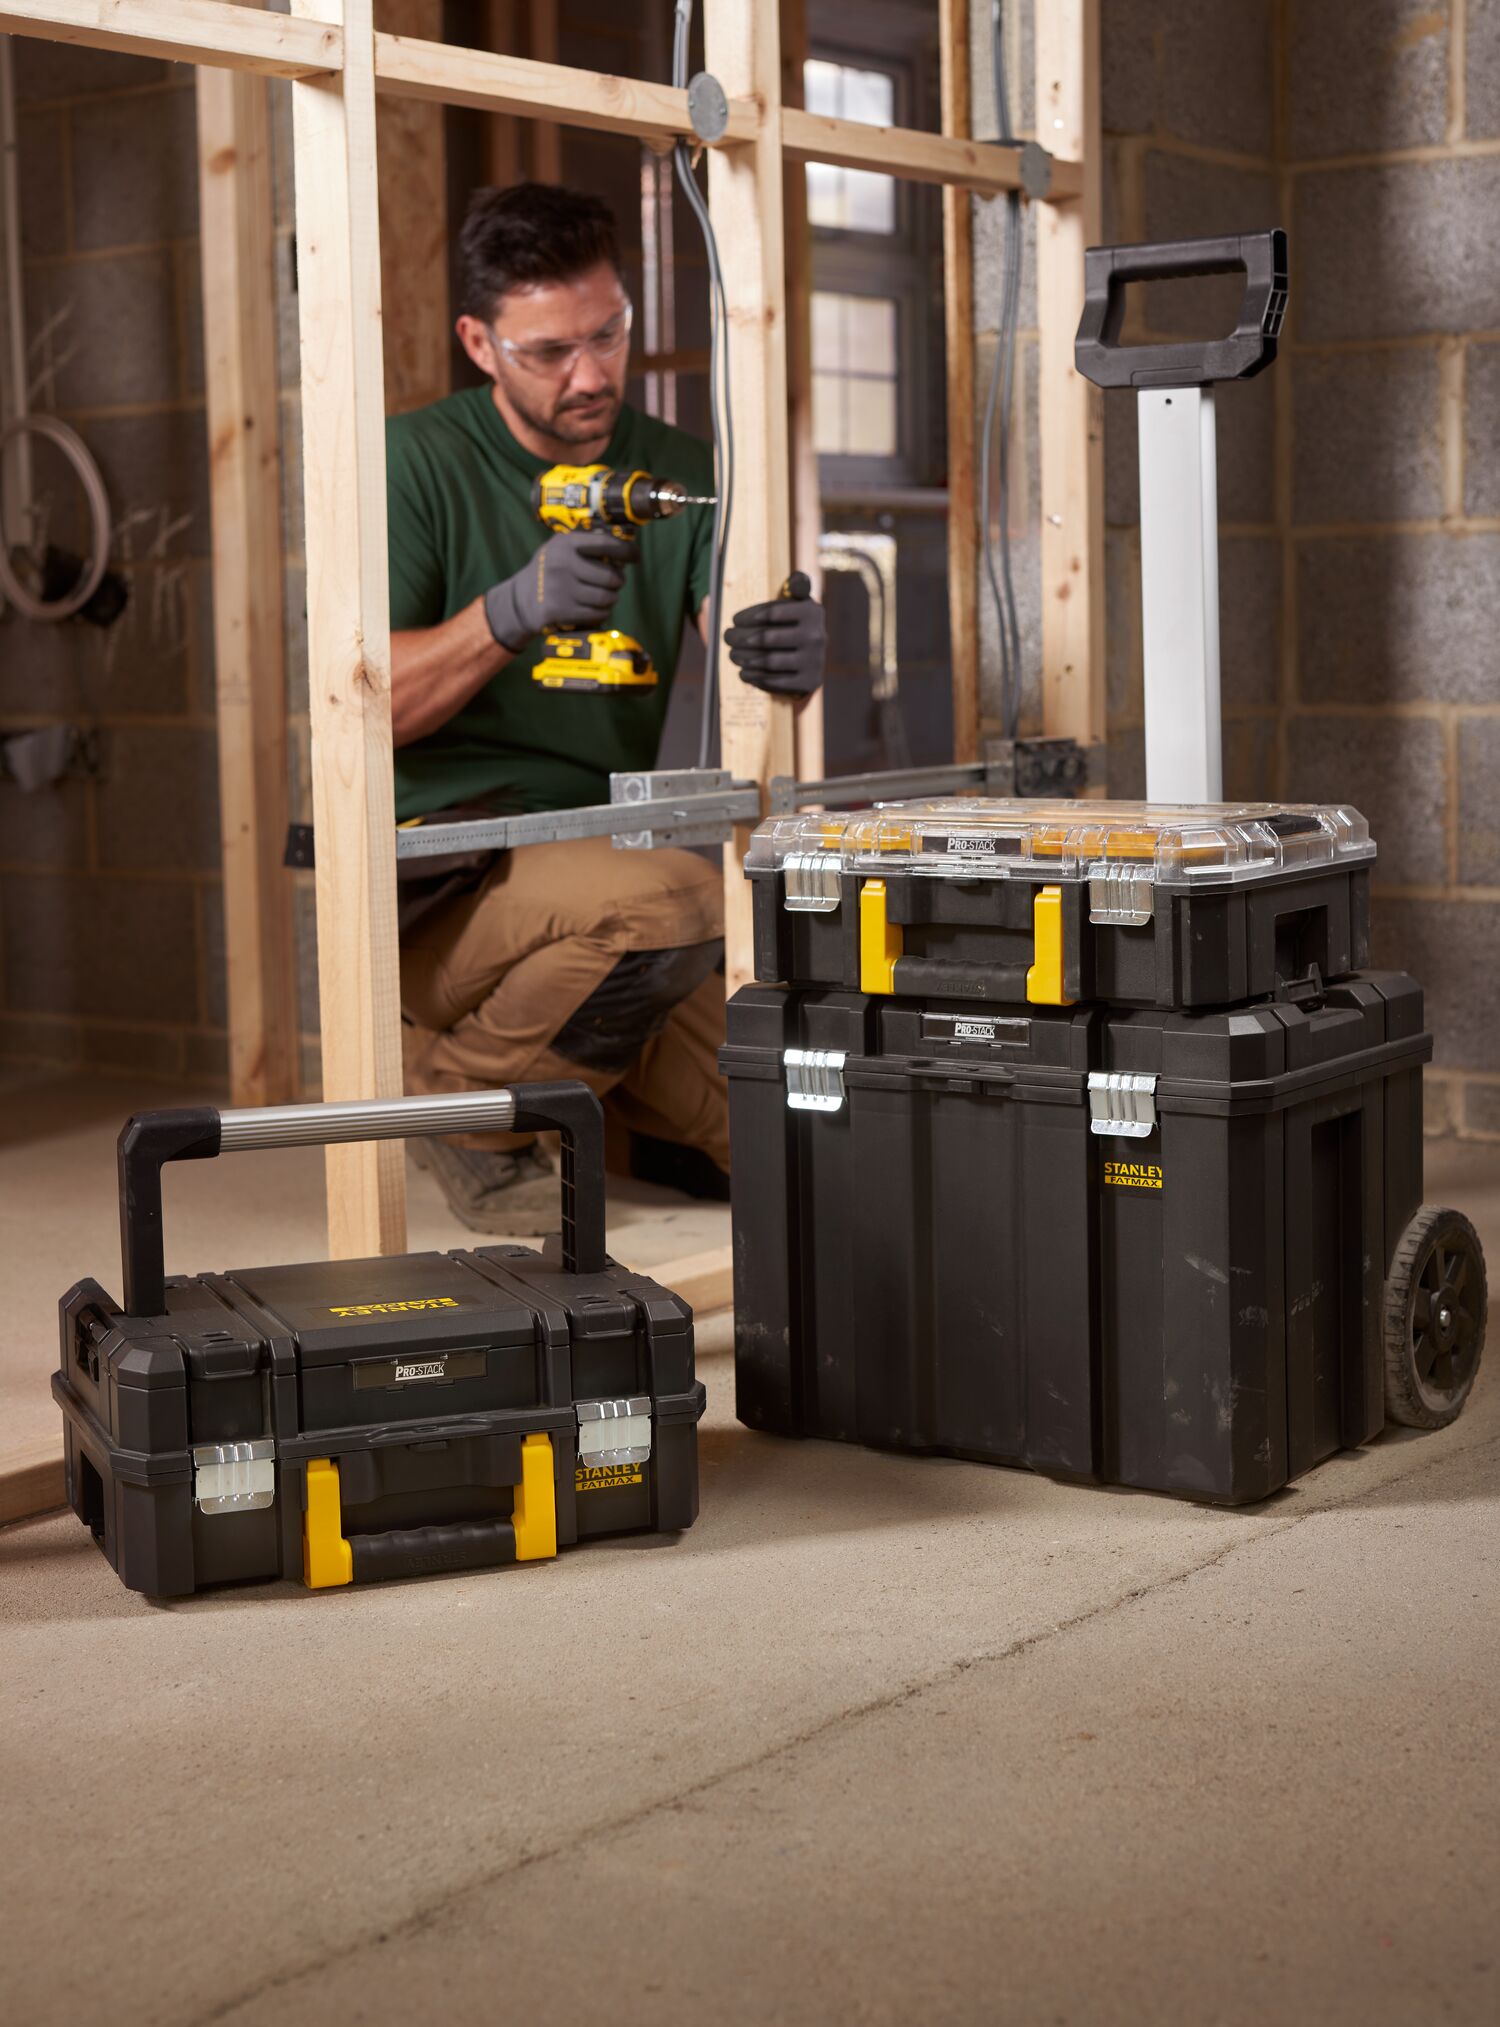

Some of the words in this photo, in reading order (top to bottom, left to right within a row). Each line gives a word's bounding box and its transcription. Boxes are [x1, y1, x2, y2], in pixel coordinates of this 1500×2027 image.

[947, 837, 996, 851] PRO-STACK
[955, 1022, 996, 1037] PRO-STACK
[1104, 1161, 1163, 1178] STANLEY
[1110, 1176, 1159, 1187] FATMAX
[337, 1301, 460, 1317] STANLEY
[395, 1363, 445, 1378] PRO-STACK
[575, 1462, 641, 1480] STANLEY
[581, 1476, 634, 1490] FATMAX
